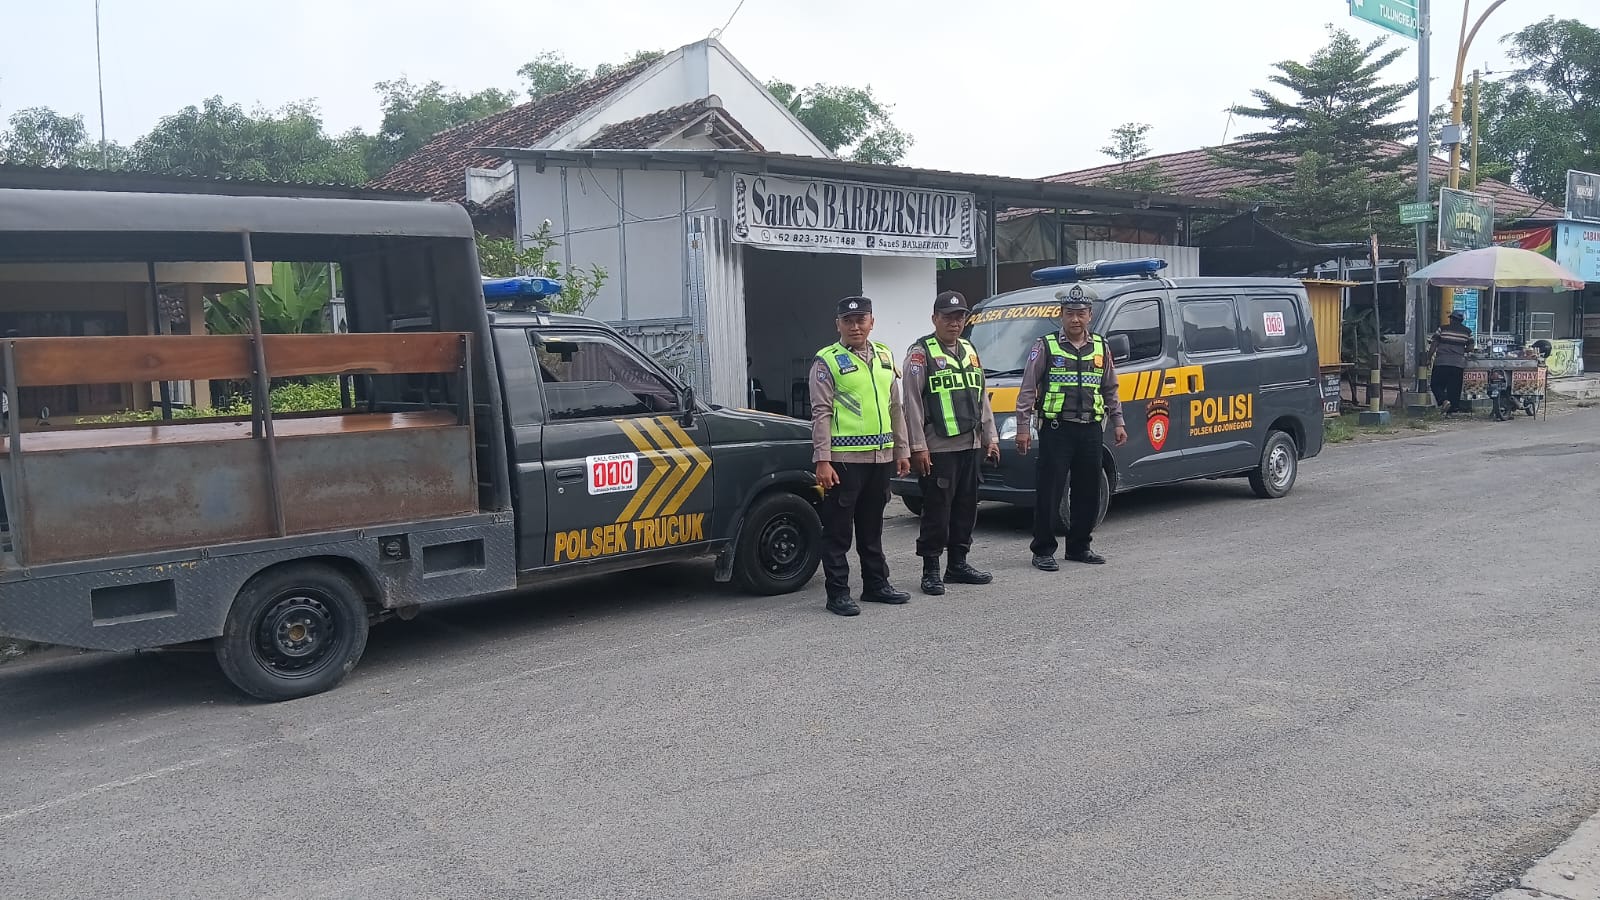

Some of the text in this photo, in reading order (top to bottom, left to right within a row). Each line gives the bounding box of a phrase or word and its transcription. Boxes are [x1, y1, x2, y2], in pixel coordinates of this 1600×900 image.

[1379, 4, 1417, 29] TULUNGREJO
[752, 178, 957, 236] SaneS BARBERSHOP
[1456, 212, 1482, 233] RAPTOR
[878, 237, 949, 250] SaneS BARBERSHOP
[965, 308, 1006, 326] POLSEK
[1464, 372, 1487, 380] SOMAY
[1513, 372, 1538, 380] SOMAY
[1190, 393, 1253, 427] POLISI
[1189, 420, 1252, 437] POLSEK BOJONEGORO
[594, 461, 633, 487] 110
[554, 513, 705, 562] POLSEK TRUCUK
